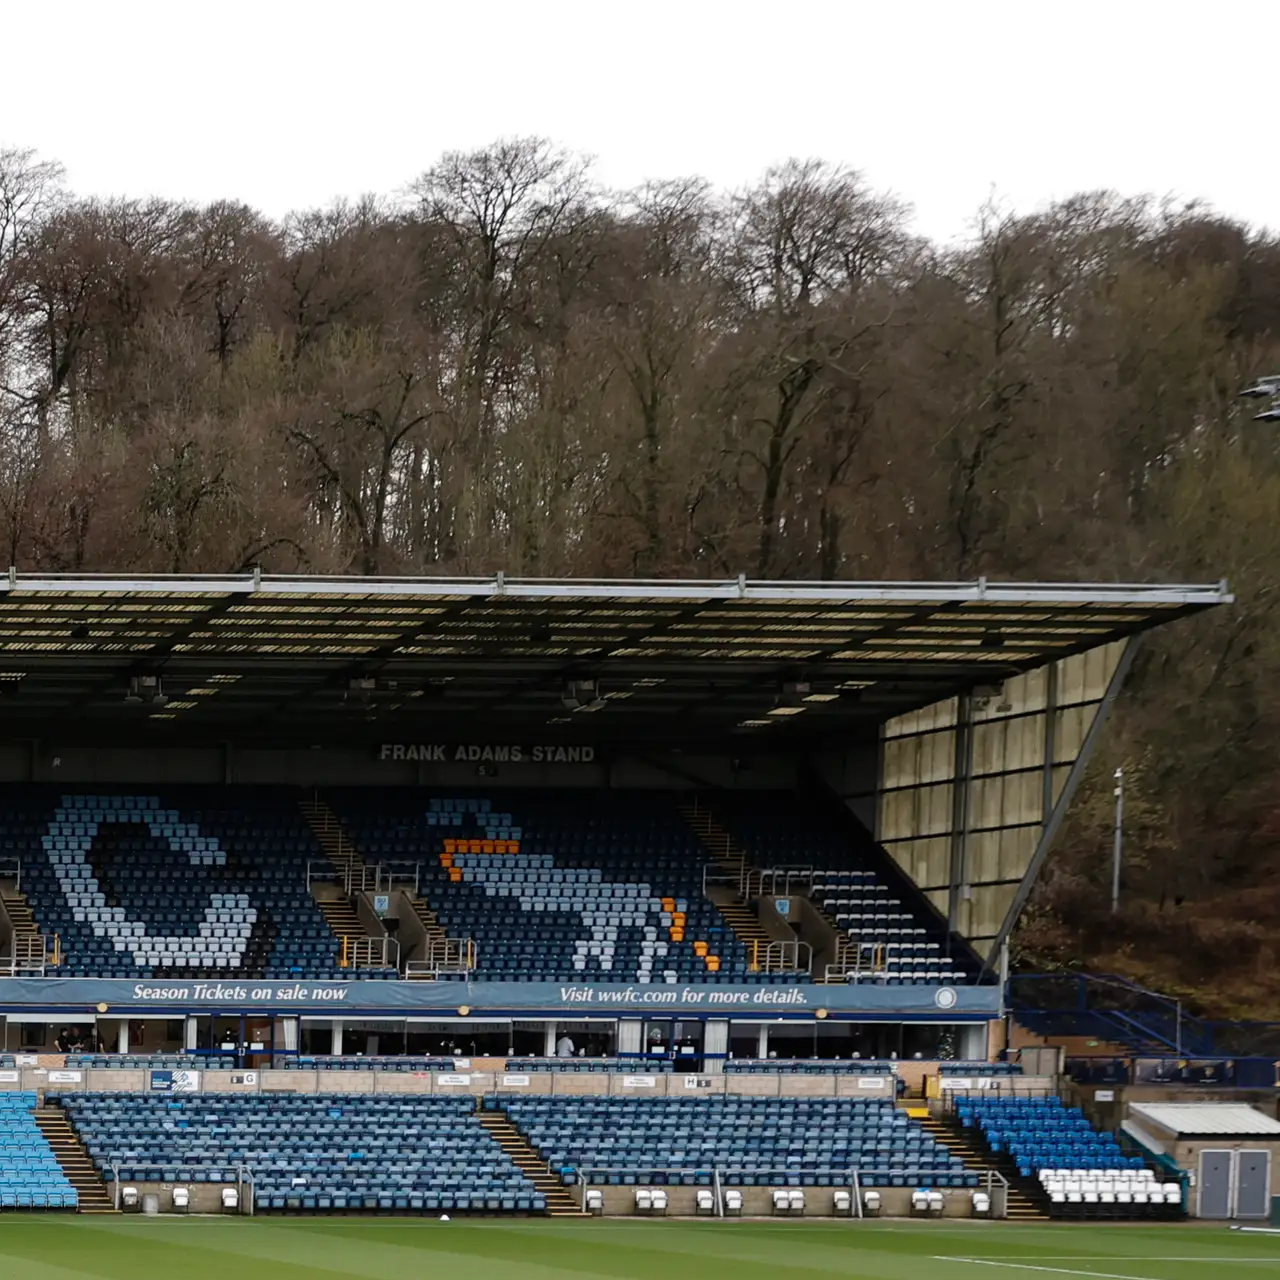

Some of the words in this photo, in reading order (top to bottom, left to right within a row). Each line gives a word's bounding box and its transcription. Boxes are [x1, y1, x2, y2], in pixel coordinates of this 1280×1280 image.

[381, 744, 446, 760] FRANK
[454, 745, 522, 761] ADAMS
[532, 746, 594, 761] STAND
[132, 984, 189, 999] Season
[193, 984, 247, 1000] Tickets
[251, 988, 272, 1000] on
[275, 984, 308, 1000] sale
[311, 988, 348, 1000] now
[560, 987, 594, 1002] Visit
[598, 987, 677, 1003] wwfc.com
[681, 987, 705, 1003] for
[708, 991, 749, 1003] more
[753, 987, 808, 1004] details.
[246, 1074, 253, 1083] G
